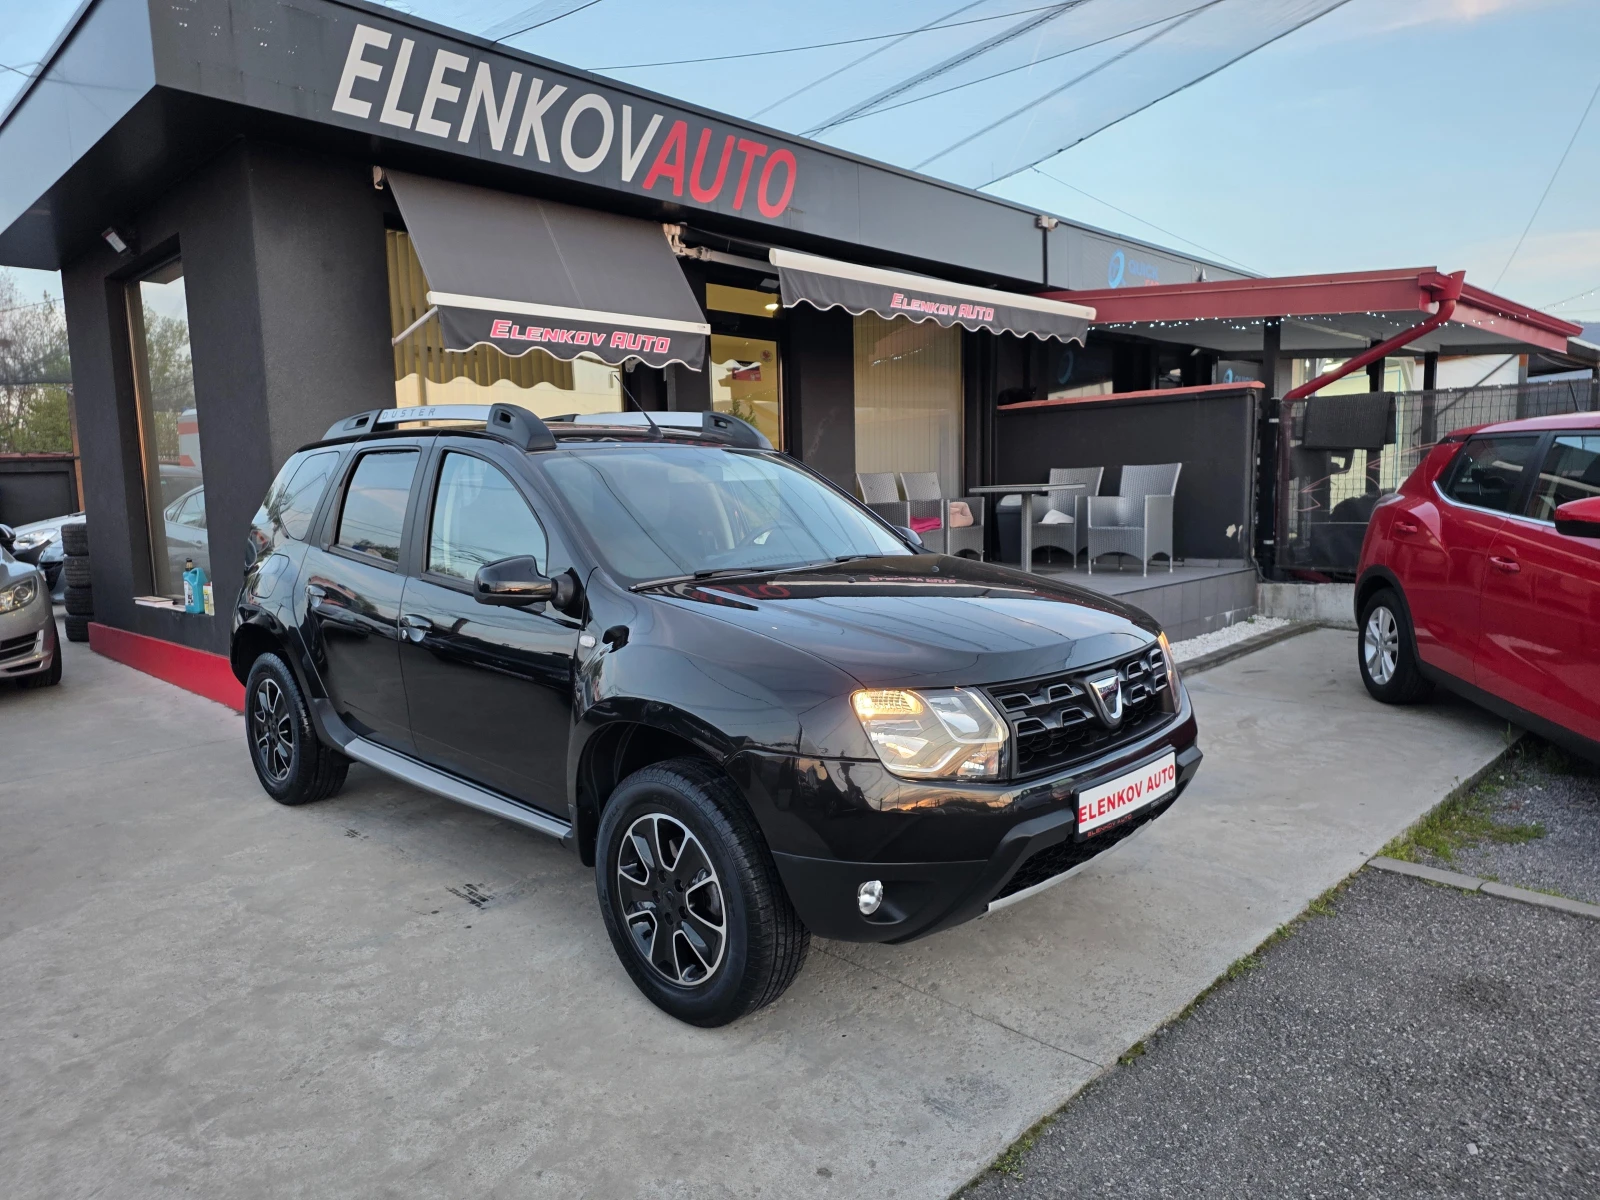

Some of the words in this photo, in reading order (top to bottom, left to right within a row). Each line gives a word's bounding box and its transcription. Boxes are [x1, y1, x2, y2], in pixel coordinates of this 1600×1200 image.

[958, 303, 994, 321] AUTO
[610, 331, 671, 353] AUTO
[382, 408, 436, 420] DUSTER
[1077, 780, 1143, 824] ELENKOV
[1147, 764, 1175, 793] AUTO
